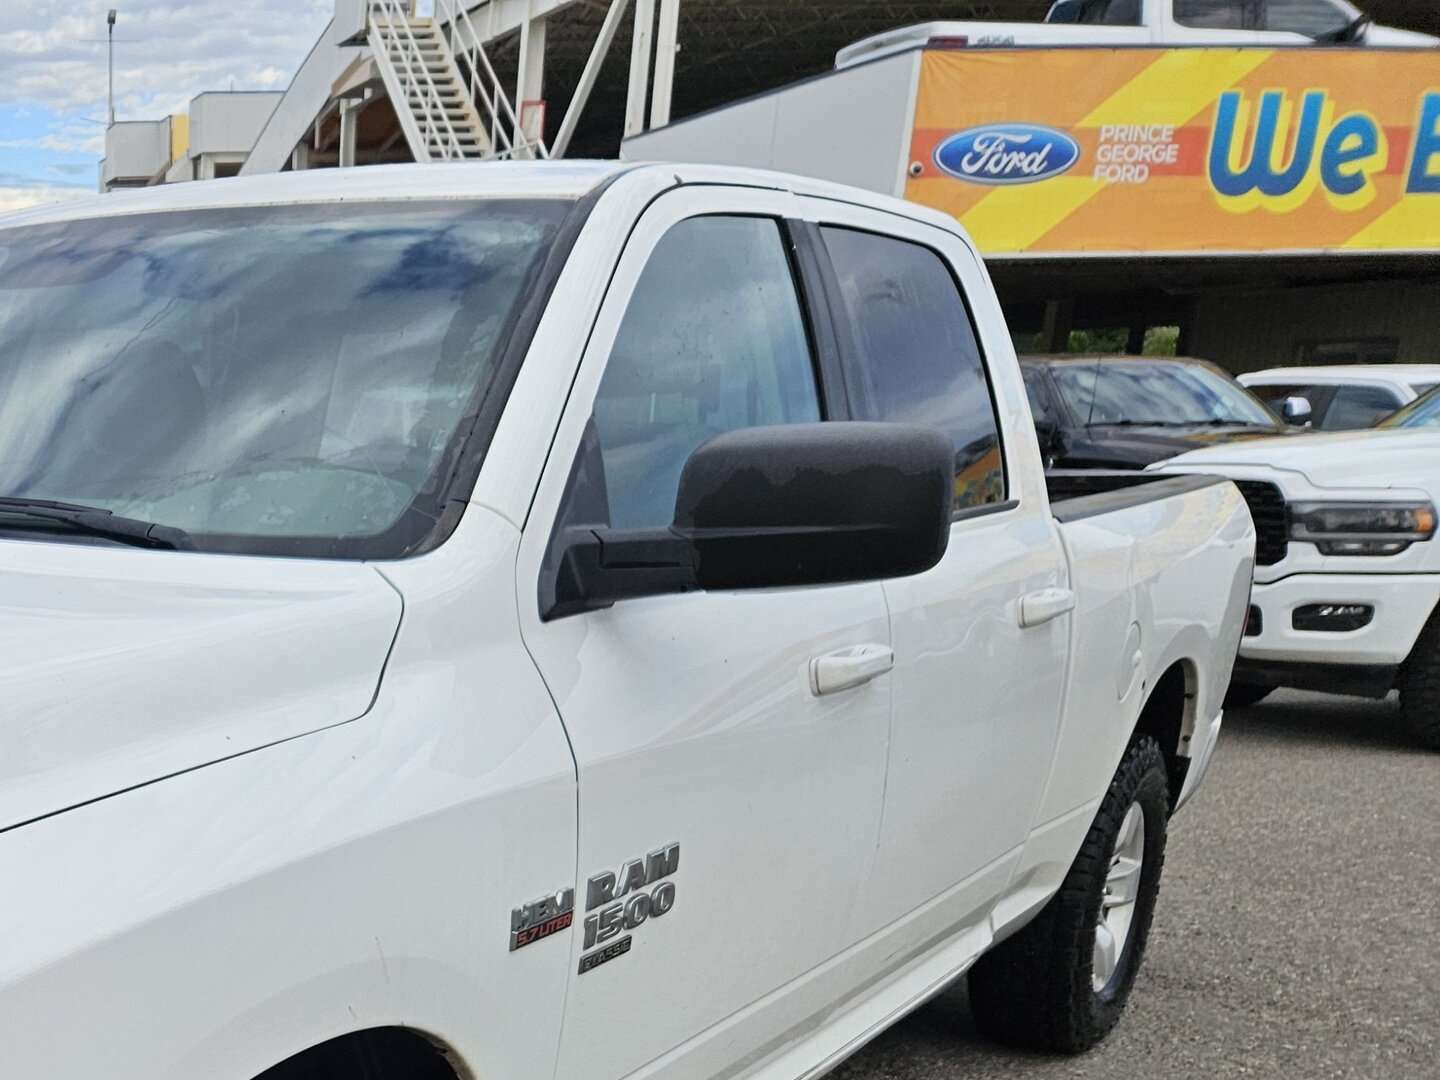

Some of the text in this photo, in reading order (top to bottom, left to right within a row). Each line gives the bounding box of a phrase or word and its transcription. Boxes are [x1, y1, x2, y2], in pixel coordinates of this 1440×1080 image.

[961, 132, 1052, 174] Ford
[1096, 143, 1179, 163] GEORGE
[1100, 124, 1175, 142] PRINCE
[1208, 89, 1381, 201] We
[1093, 163, 1150, 184] FORD
[585, 841, 680, 914] RAM
[582, 881, 676, 952] 1500
